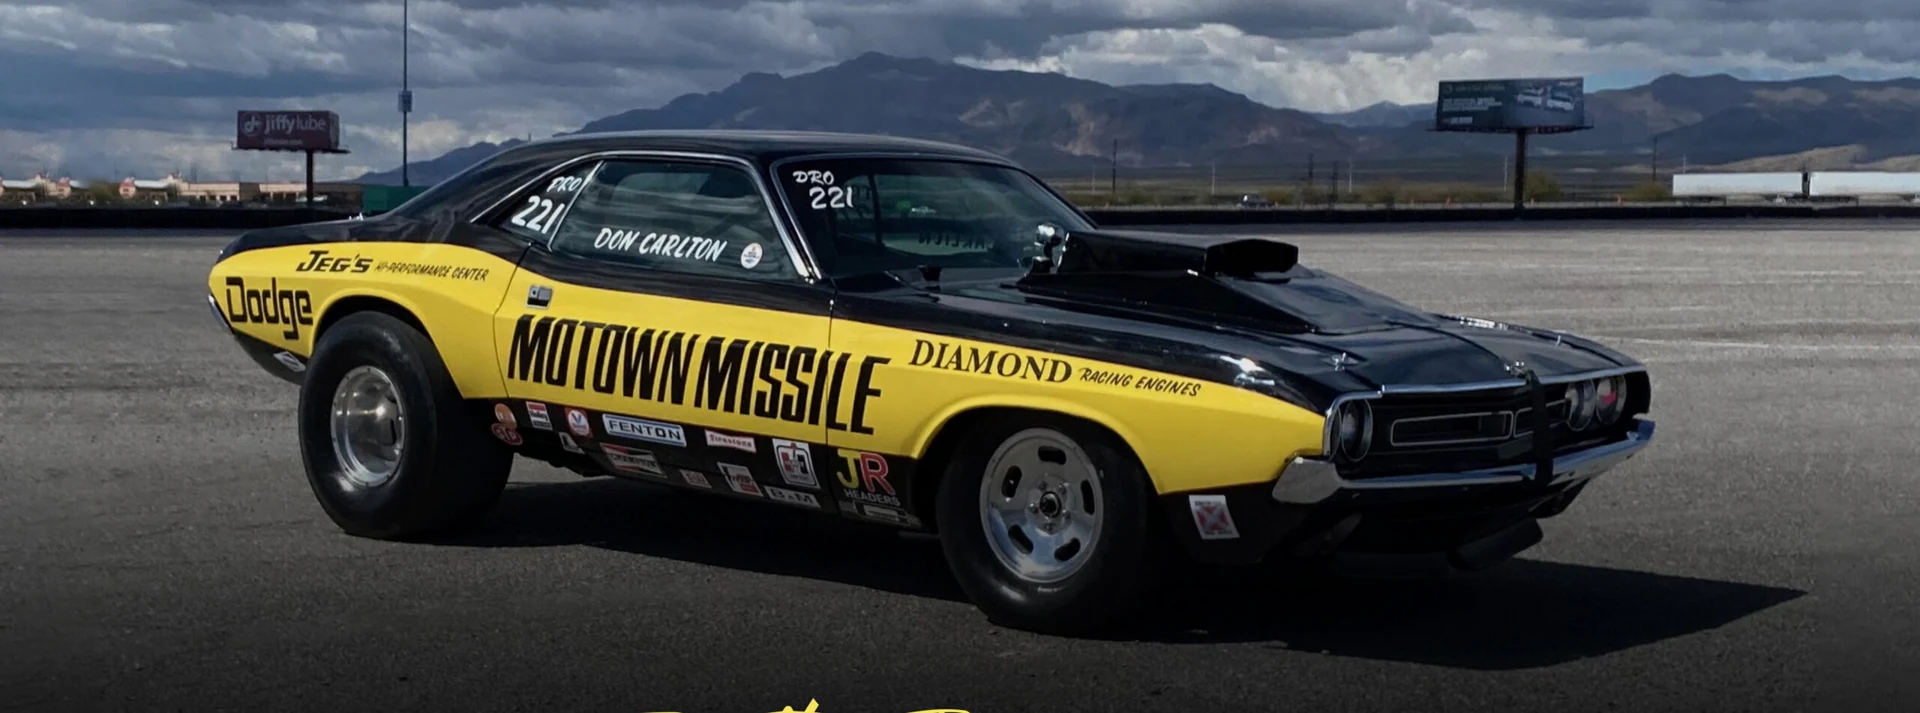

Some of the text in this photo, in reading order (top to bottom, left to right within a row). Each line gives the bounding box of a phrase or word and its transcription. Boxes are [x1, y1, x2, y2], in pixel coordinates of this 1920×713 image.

[546, 176, 582, 193] PRO
[809, 186, 854, 209] 221
[511, 195, 565, 234] 221
[594, 227, 728, 262] DON CARLTON
[375, 261, 451, 278] HI-PERFORMANCE
[451, 266, 489, 281] CENTER
[226, 276, 314, 340] Dodge
[507, 314, 892, 435] MOTOWN MISSILE
[908, 339, 1202, 397] DIAMOND RACING ENGINES
[608, 420, 681, 440] FENTON
[836, 448, 896, 496] JR
[843, 489, 901, 507] HEADERS
